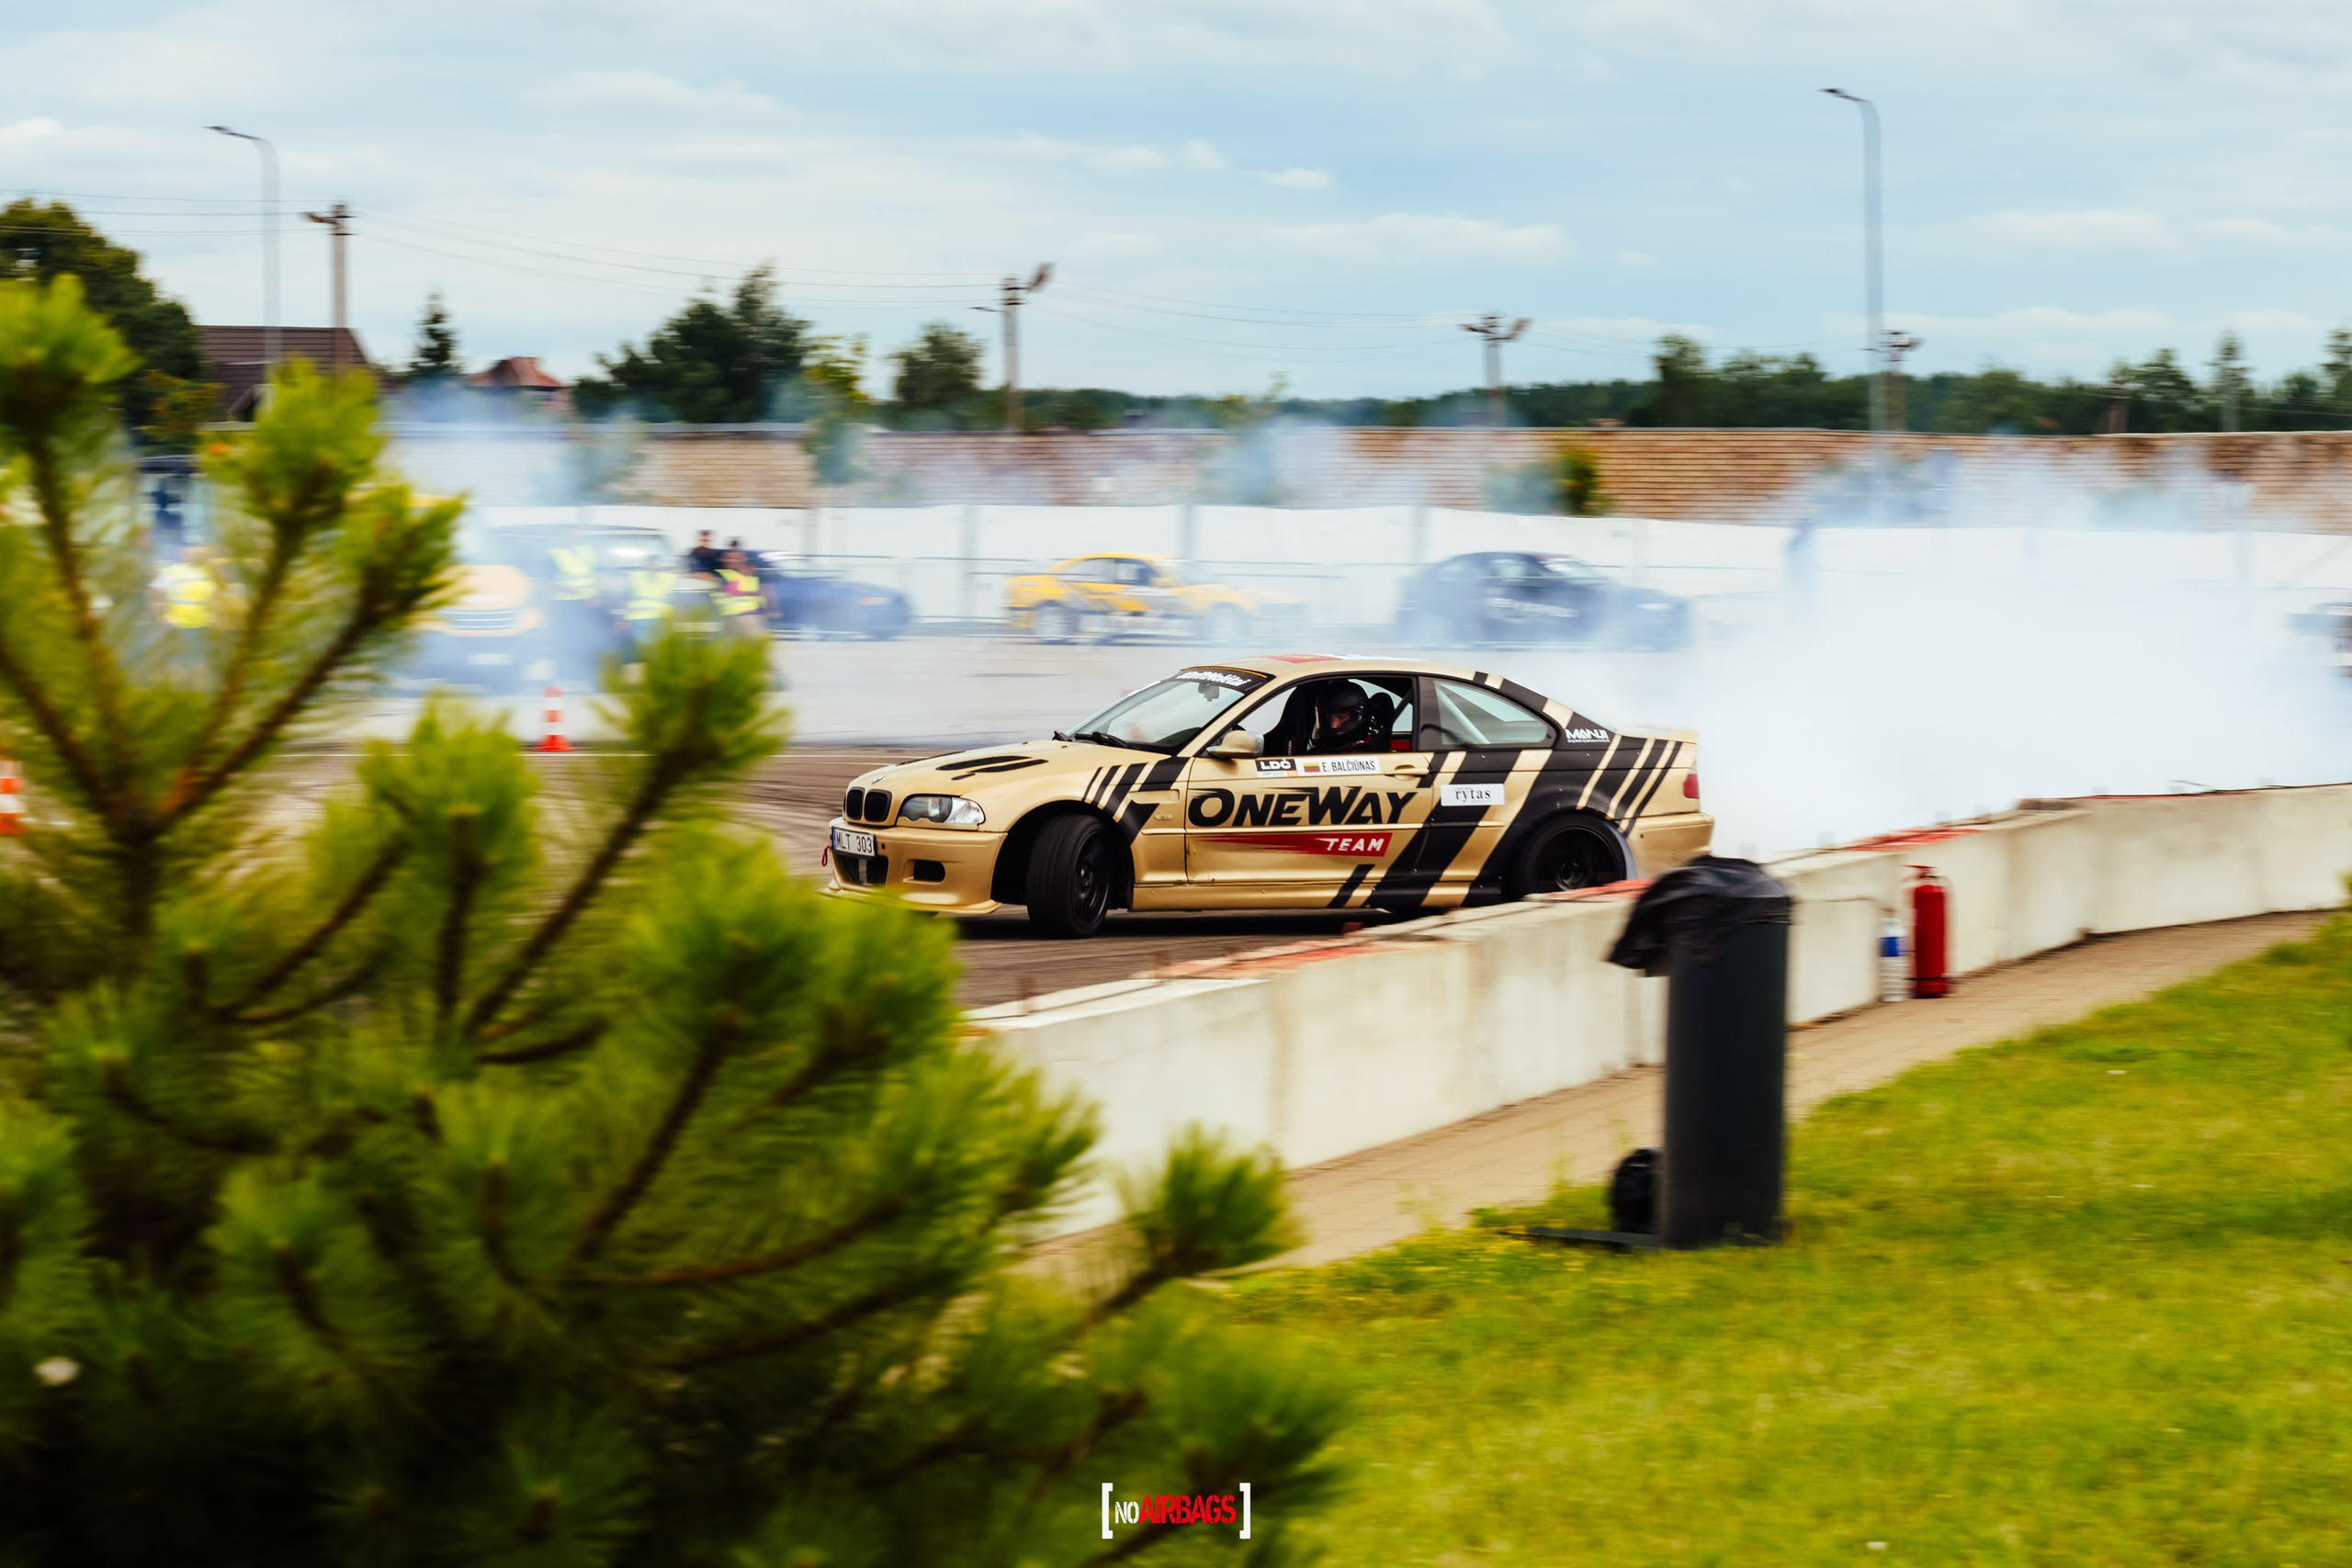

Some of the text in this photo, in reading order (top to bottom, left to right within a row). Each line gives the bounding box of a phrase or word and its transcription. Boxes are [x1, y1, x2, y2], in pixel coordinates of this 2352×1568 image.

[1322, 759, 1376, 773] E. BALČIŪNAS
[1455, 790, 1491, 803] rytas
[836, 830, 873, 853] MLT 303
[1323, 837, 1385, 852] TEAM
